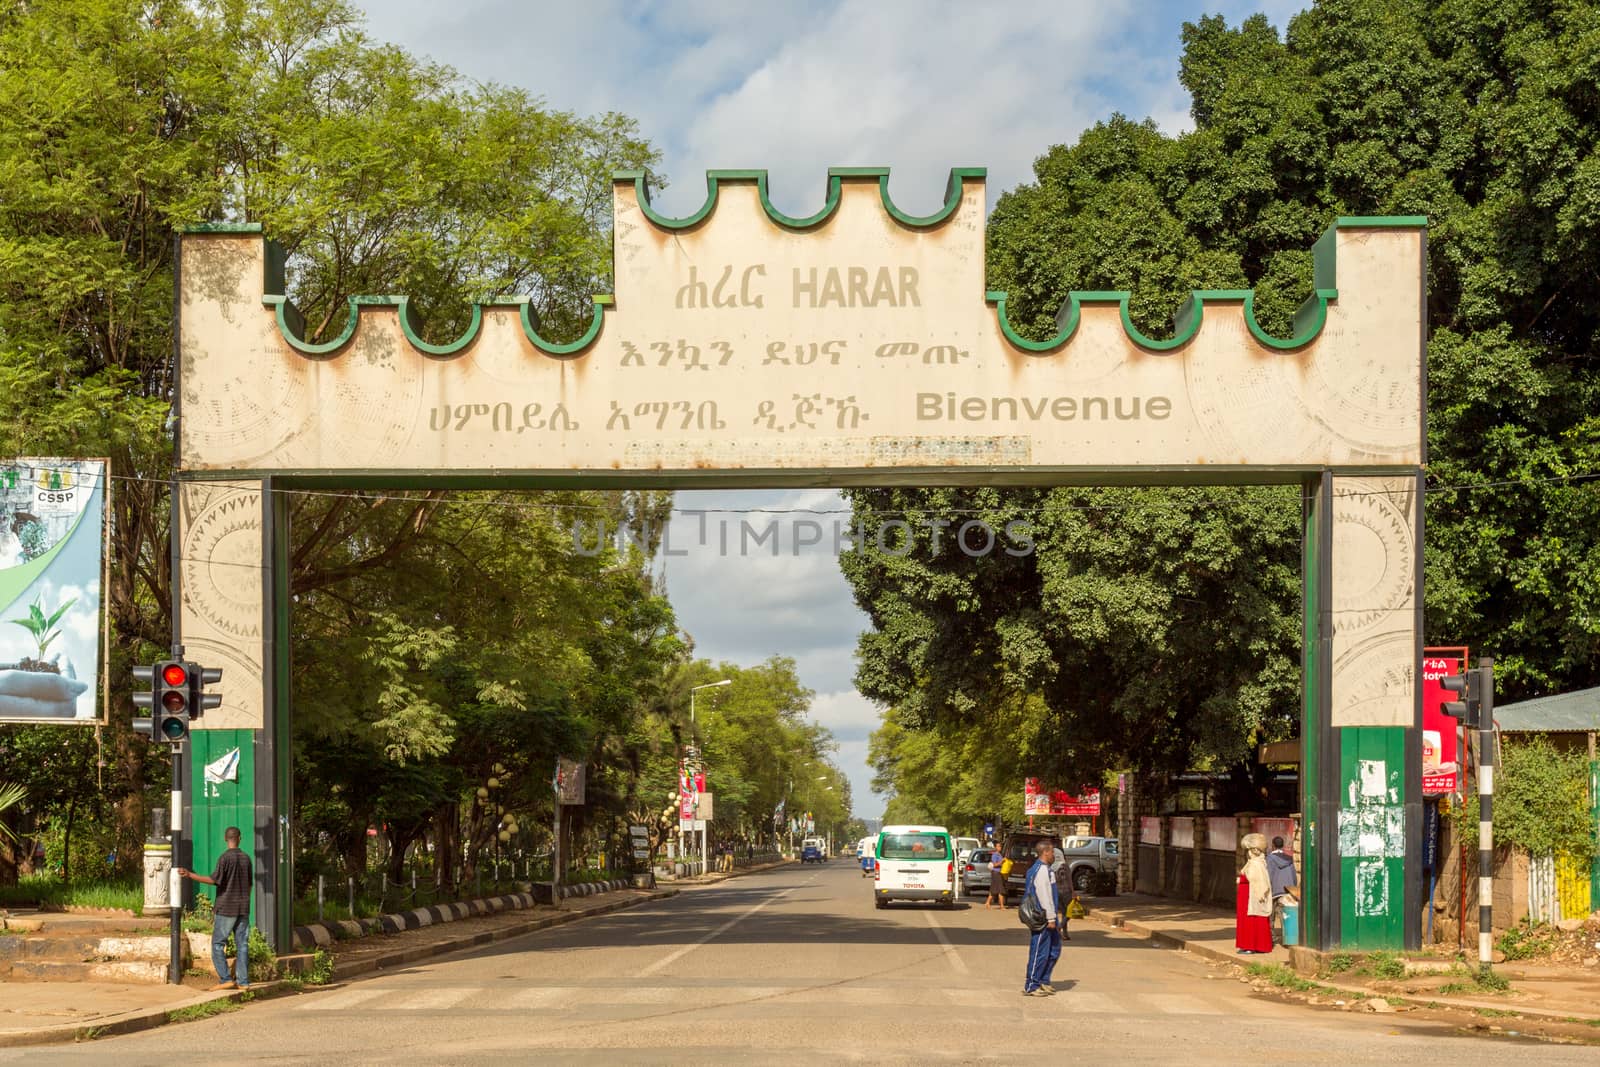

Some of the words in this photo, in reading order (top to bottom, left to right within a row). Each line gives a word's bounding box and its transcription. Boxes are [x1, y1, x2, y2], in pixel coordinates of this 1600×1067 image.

[675, 263, 767, 309] ሐረር
[792, 266, 922, 308] HARAR
[619, 338, 735, 371] እንኳን
[761, 340, 848, 366] ደህና
[874, 342, 970, 365] መጡ
[605, 399, 727, 431] አማንቤ
[916, 391, 1173, 422] Bienvenue
[38, 492, 74, 503] CSSP
